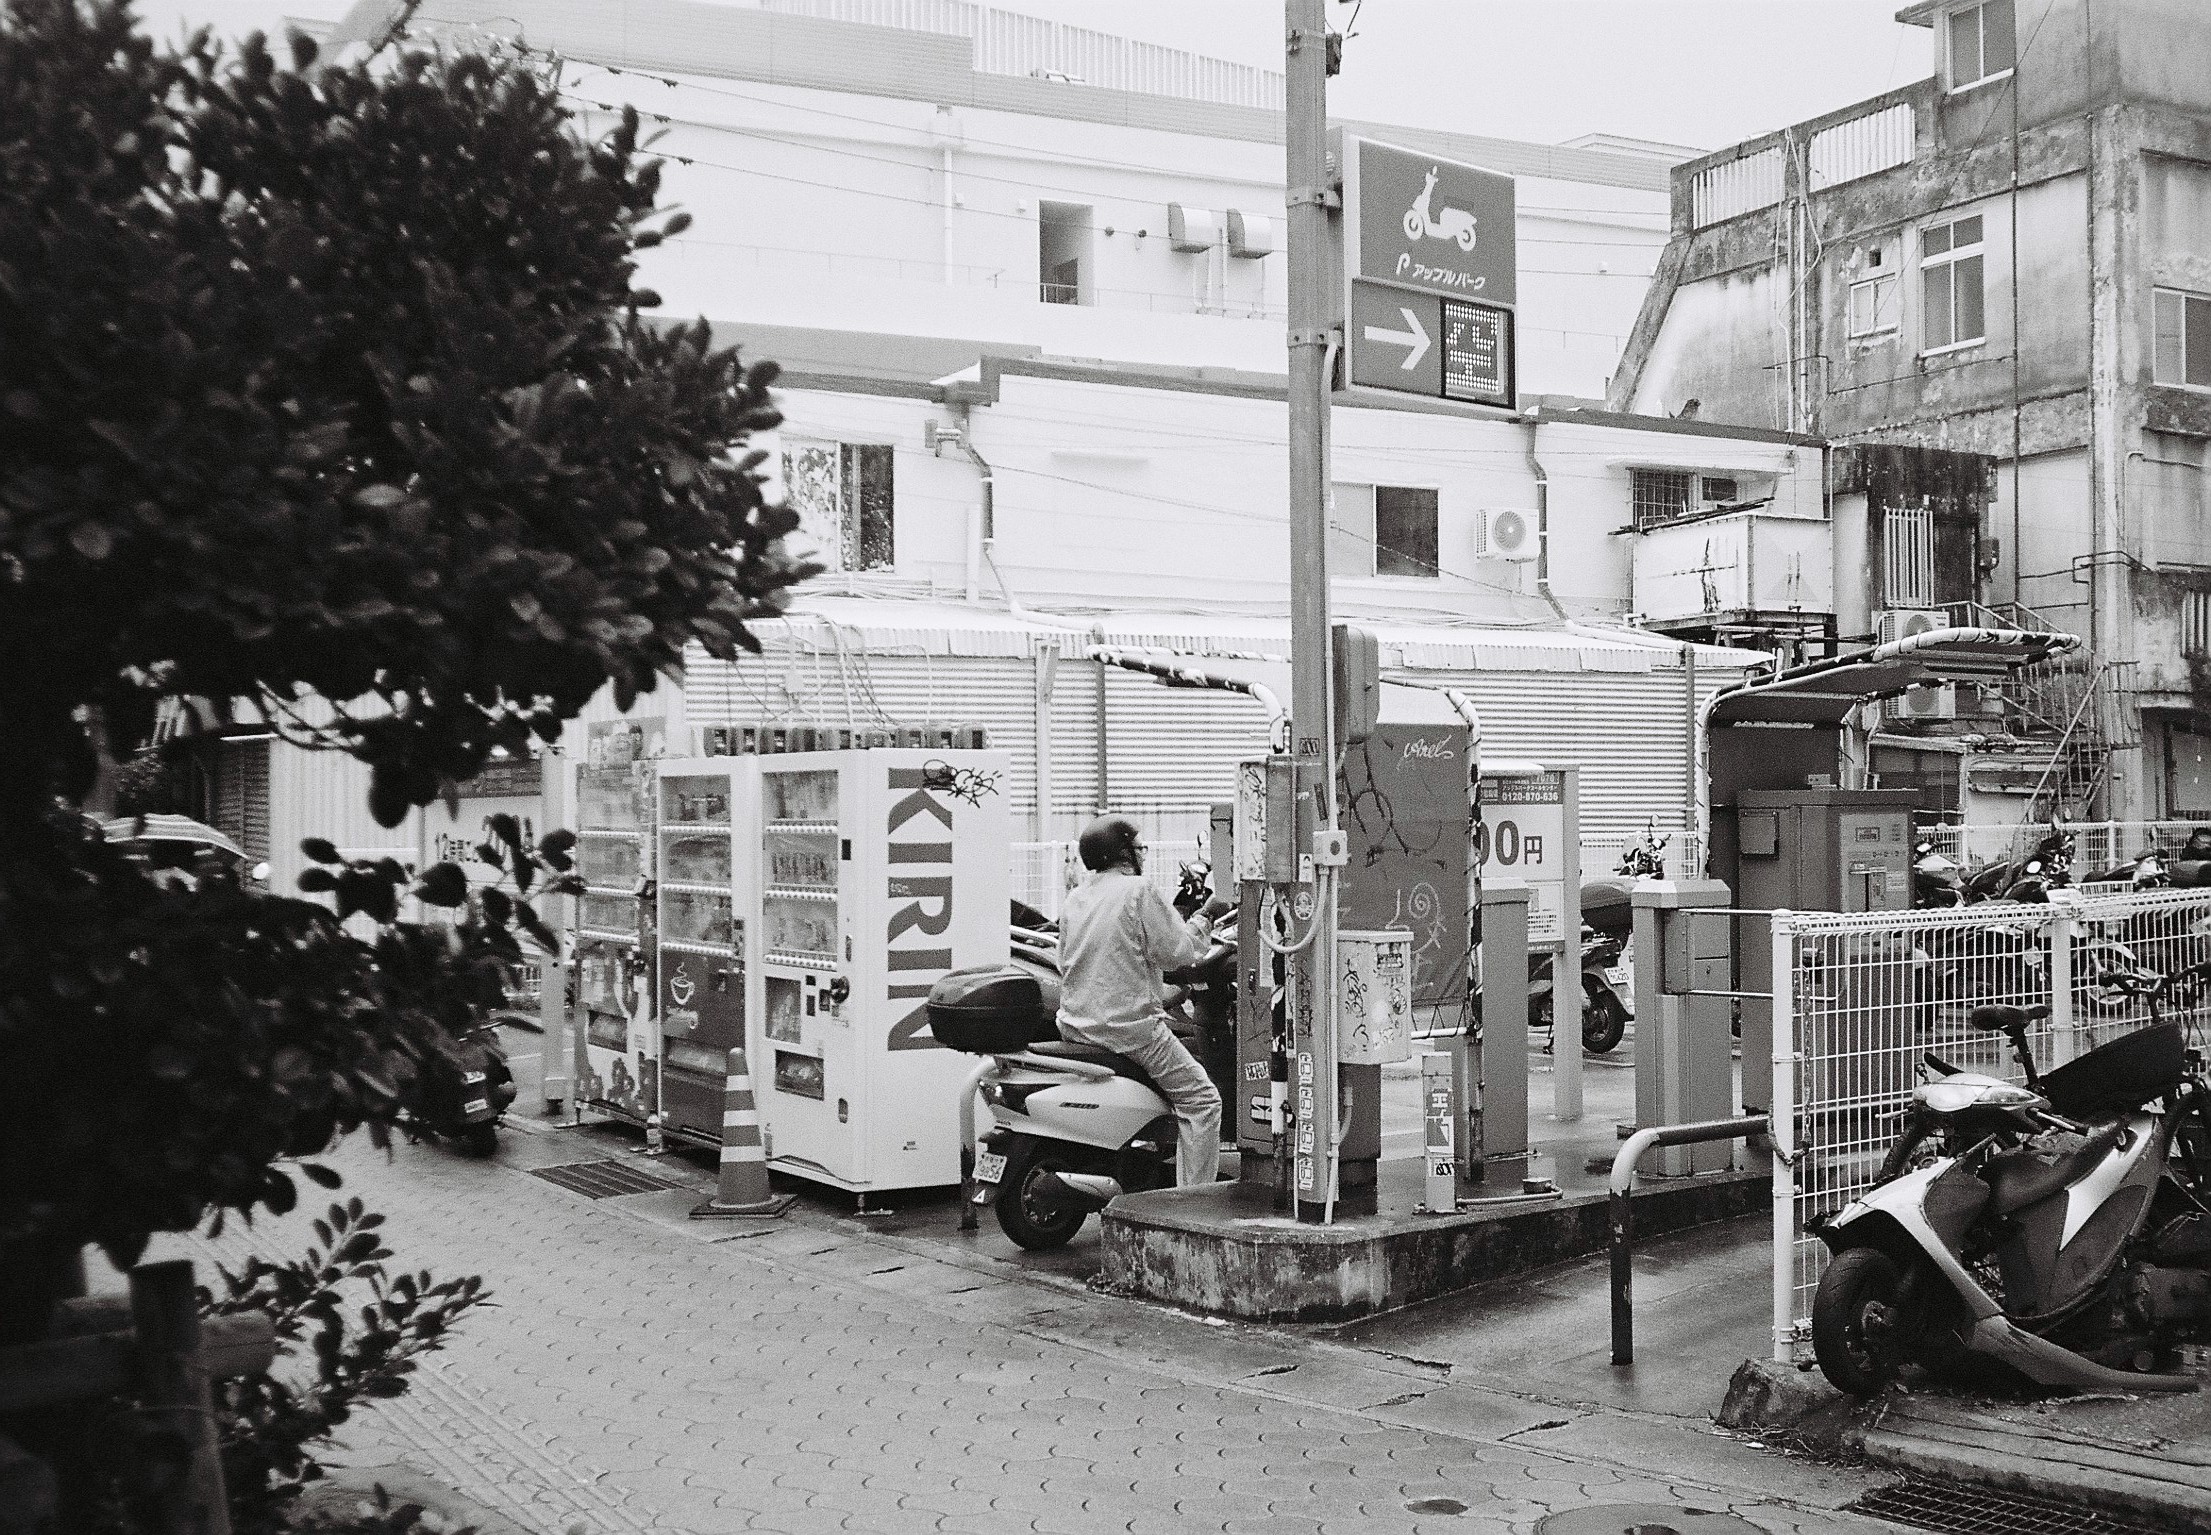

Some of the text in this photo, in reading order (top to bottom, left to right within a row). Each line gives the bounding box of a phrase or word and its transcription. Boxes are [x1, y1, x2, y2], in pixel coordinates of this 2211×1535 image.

[1412, 263, 1486, 290] アップルパーク
[1501, 791, 1559, 802] 0120-870-636
[887, 767, 953, 1052] KIRIN
